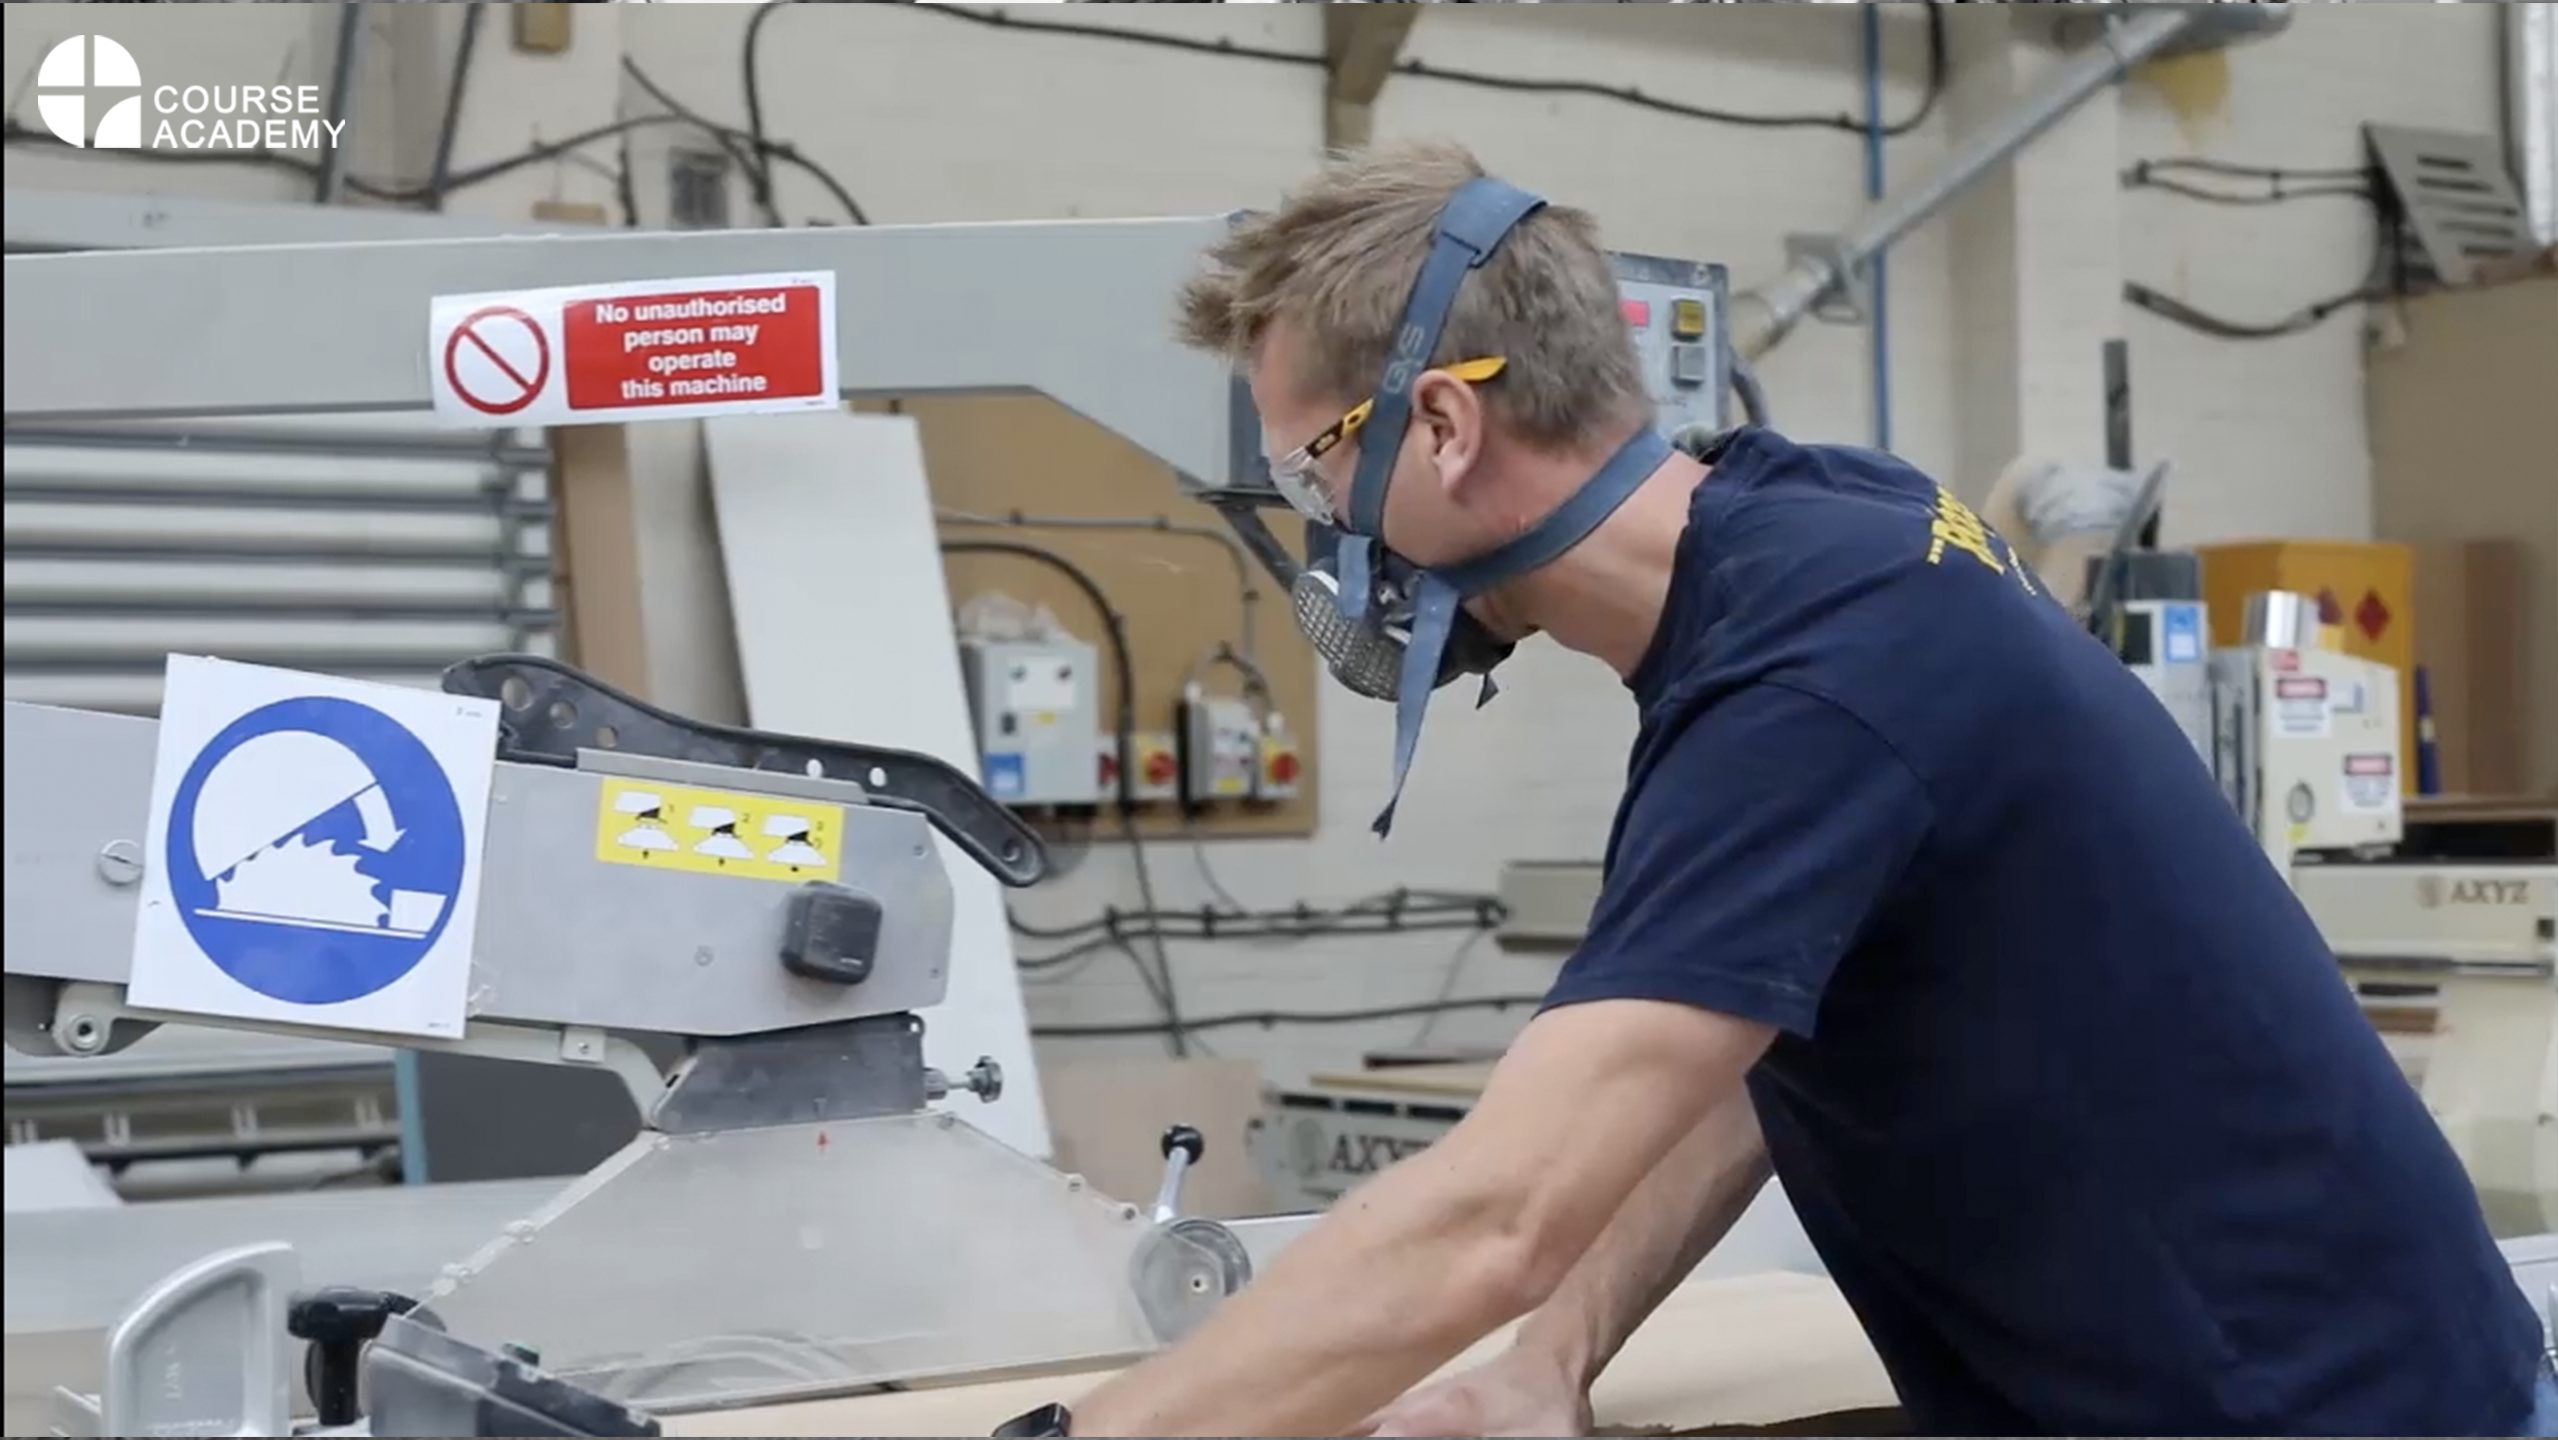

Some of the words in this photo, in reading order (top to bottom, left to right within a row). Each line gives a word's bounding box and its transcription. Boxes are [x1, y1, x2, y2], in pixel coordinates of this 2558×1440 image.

[595, 303, 629, 324] No
[634, 292, 787, 322] unauthorised
[624, 327, 705, 353] person
[710, 323, 760, 346] may
[648, 349, 737, 376] operate
[620, 379, 665, 400] this
[669, 374, 768, 397] machine
[2449, 879, 2530, 905] AXYZ
